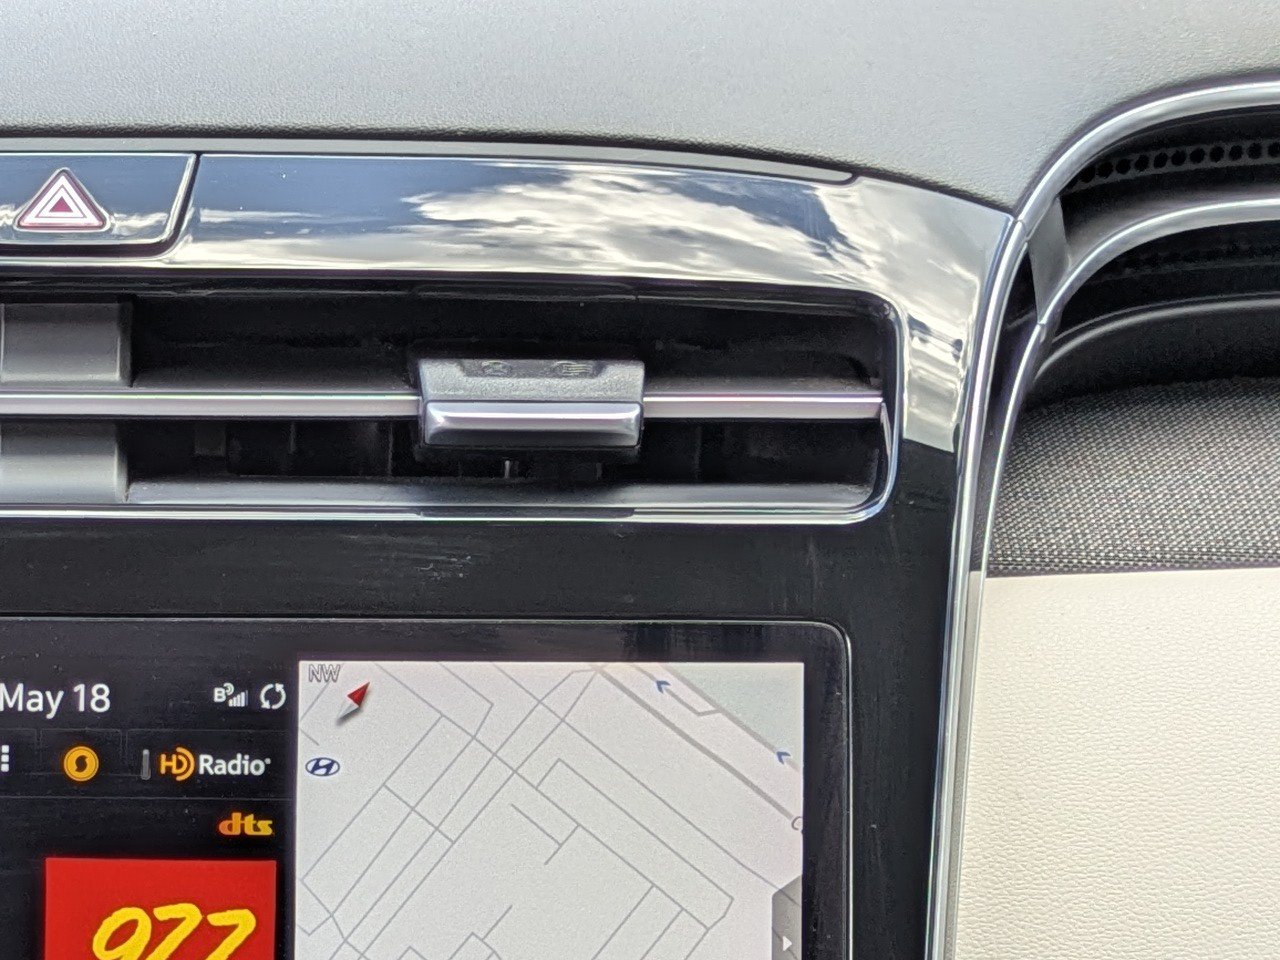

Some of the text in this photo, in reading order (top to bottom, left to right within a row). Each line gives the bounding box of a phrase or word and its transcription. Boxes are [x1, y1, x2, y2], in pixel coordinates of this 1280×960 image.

[308, 664, 341, 682] NW
[73, 683, 111, 713] 18
[218, 812, 274, 836] dts
